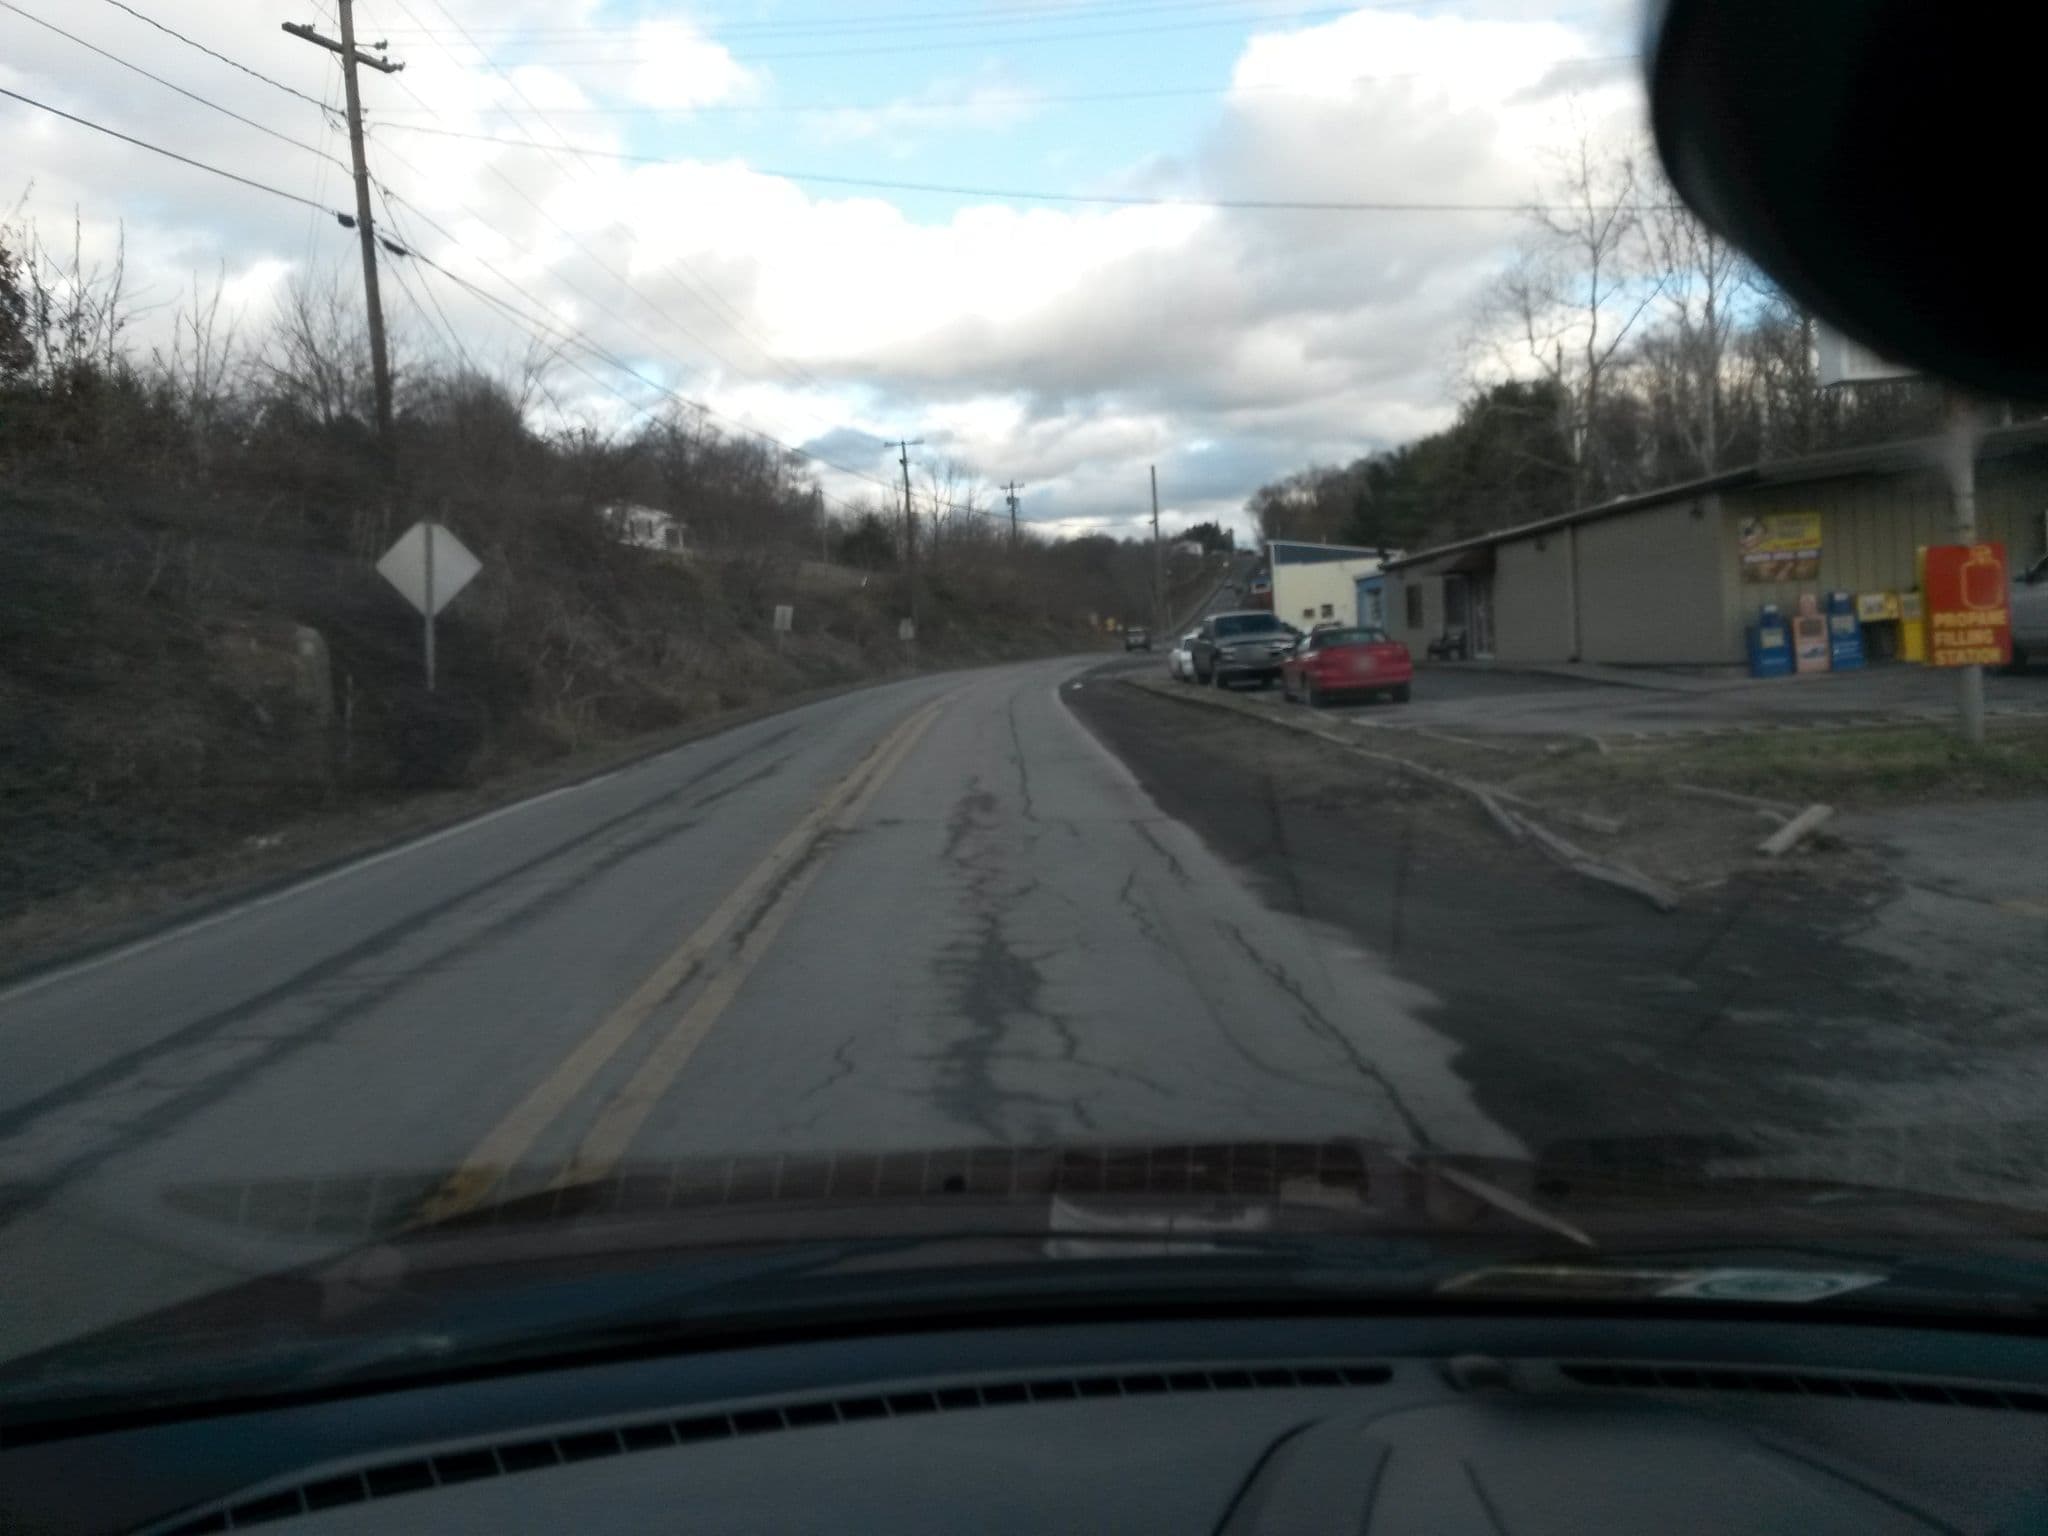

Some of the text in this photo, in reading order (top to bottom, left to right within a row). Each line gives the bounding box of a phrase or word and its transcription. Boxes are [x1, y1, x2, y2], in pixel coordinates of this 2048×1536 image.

[1933, 609, 2006, 627] PROPANE
[1934, 628, 1994, 647] FILLING
[1935, 648, 2002, 665] STATION
